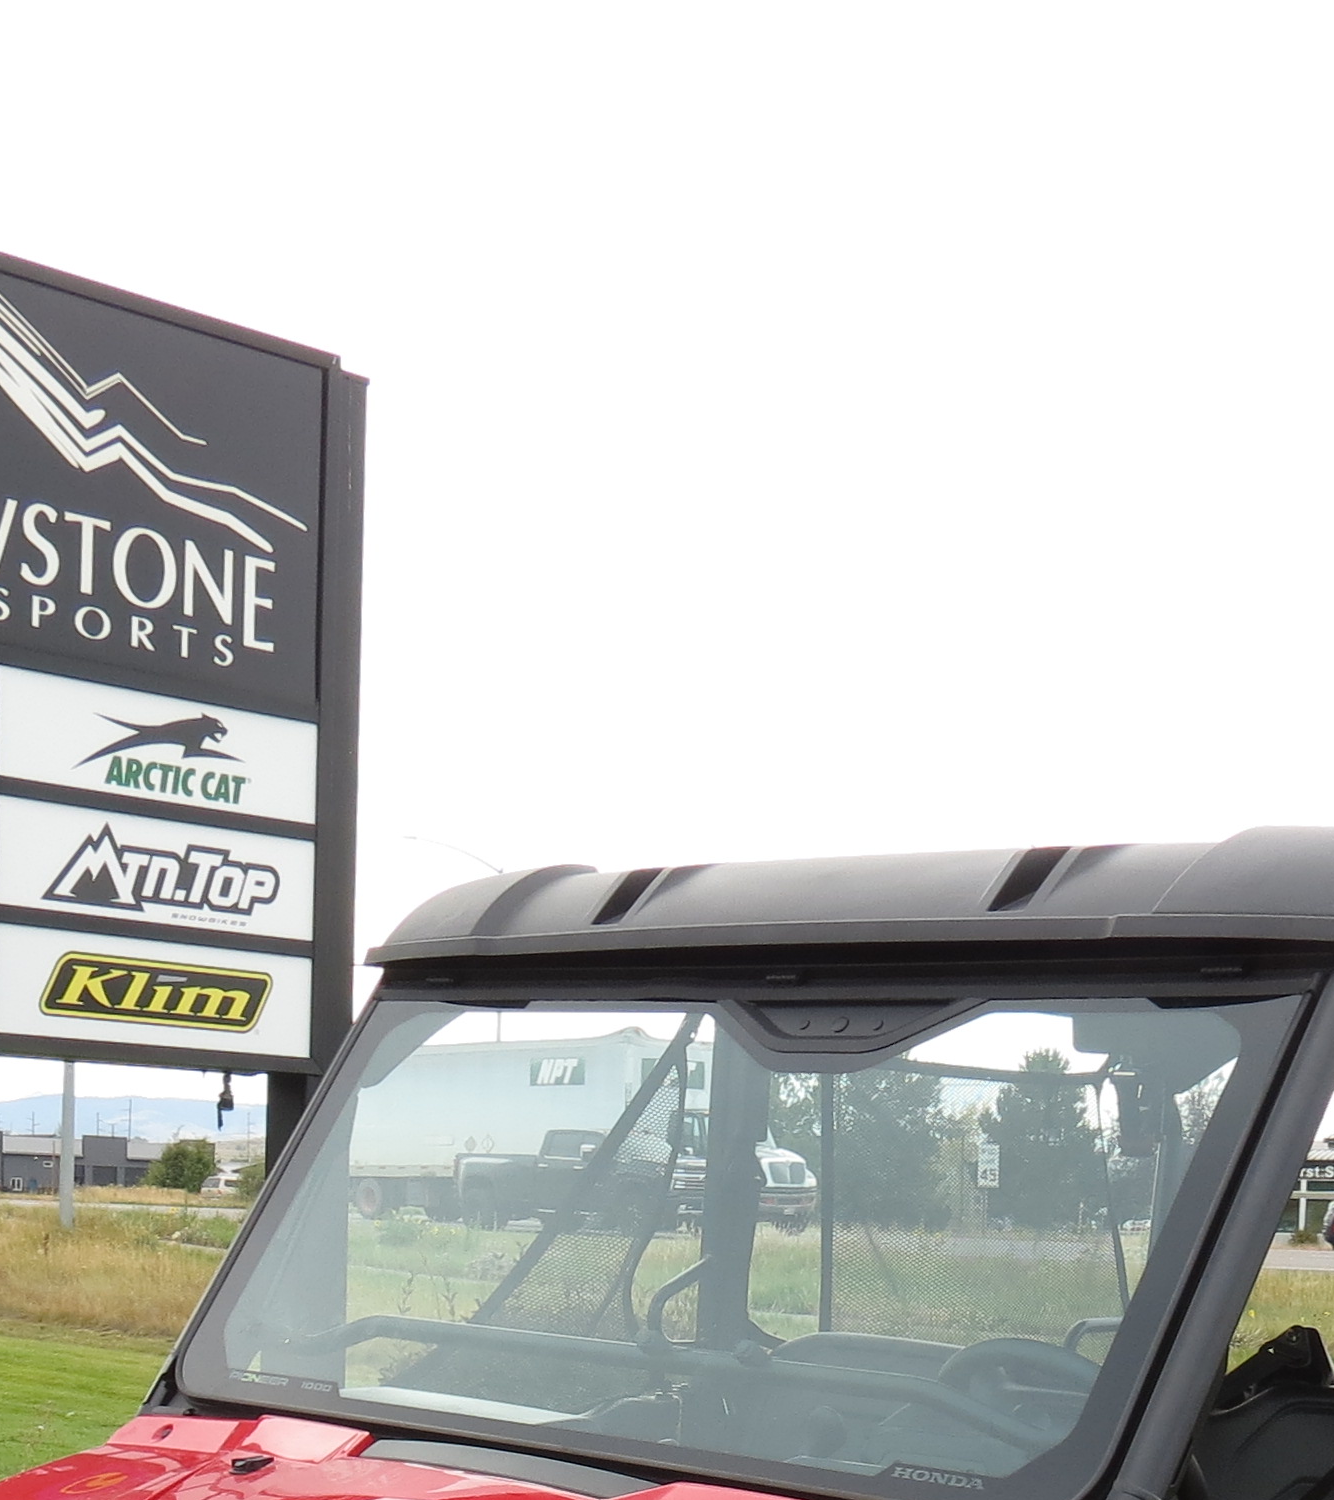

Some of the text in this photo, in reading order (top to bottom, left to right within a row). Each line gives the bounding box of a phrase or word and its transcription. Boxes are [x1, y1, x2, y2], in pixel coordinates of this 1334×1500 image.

[105, 755, 247, 805] ARCTIC CAT
[55, 964, 252, 1021] Klim
[536, 1058, 579, 1085] NPT
[891, 1466, 985, 1490] HONDA
